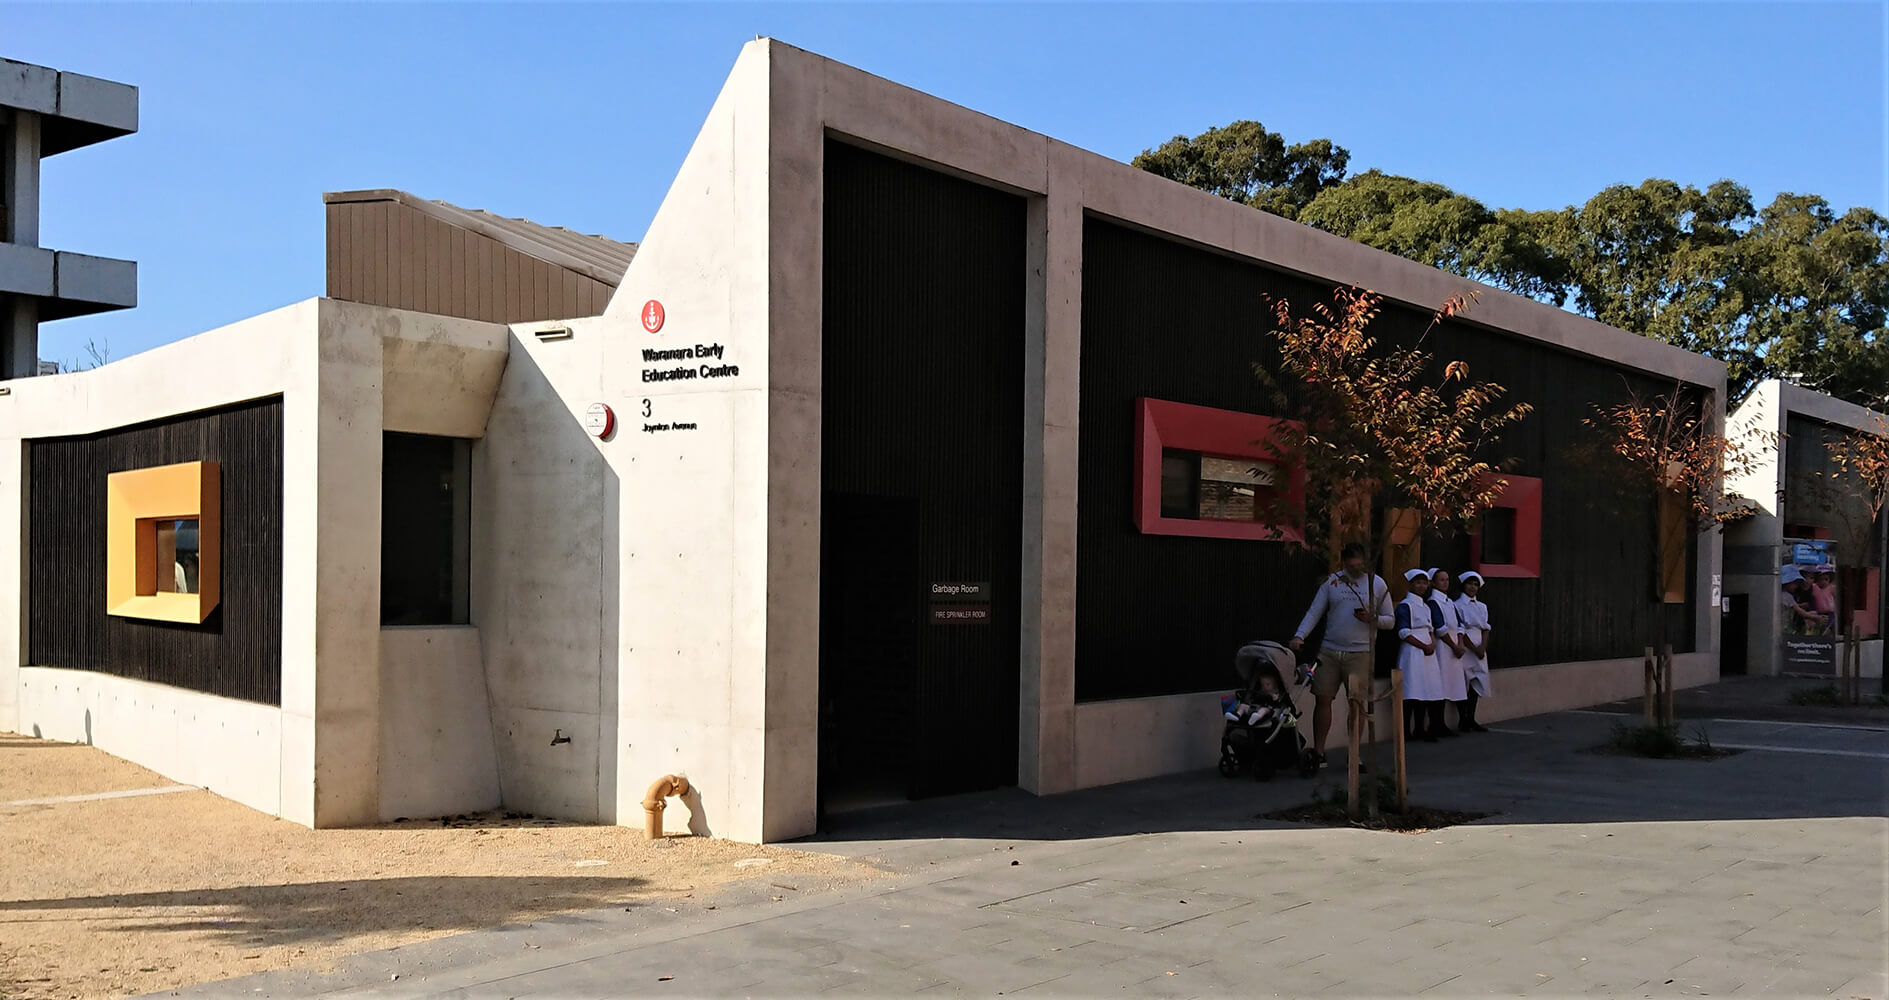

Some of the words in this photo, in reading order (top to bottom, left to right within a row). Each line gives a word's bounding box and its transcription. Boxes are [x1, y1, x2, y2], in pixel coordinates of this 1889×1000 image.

[642, 348, 693, 362] Waranara
[695, 342, 724, 360] Early
[642, 367, 697, 382] Education
[700, 364, 739, 379] Centre
[642, 398, 652, 418] 3
[671, 422, 697, 430] Avenue
[932, 583, 960, 595] Garbage
[960, 584, 979, 593] Room
